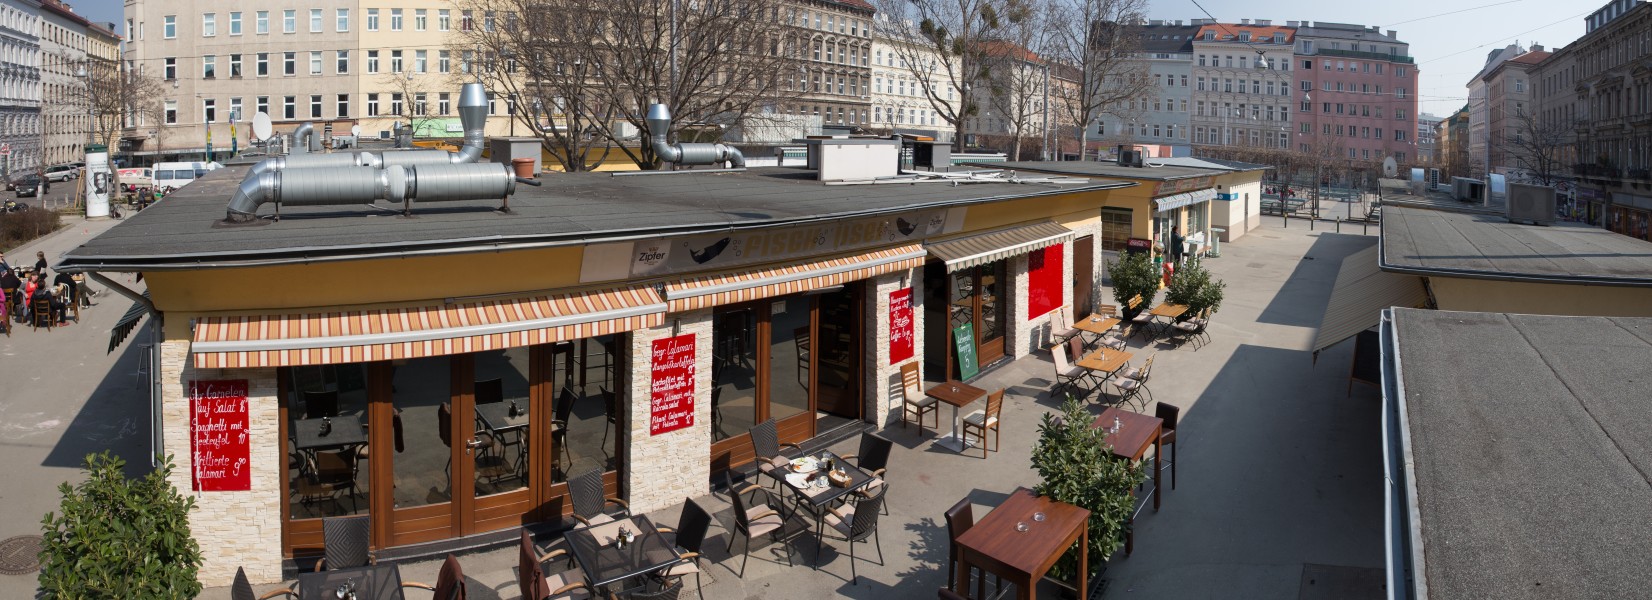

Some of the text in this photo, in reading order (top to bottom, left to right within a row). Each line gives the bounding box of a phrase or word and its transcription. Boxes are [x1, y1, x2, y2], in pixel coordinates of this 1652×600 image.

[639, 252, 665, 262] Zipfer
[667, 340, 693, 355] Calamari
[190, 386, 206, 406] Ggr.
[214, 399, 236, 413] Salat
[231, 421, 242, 430] mit
